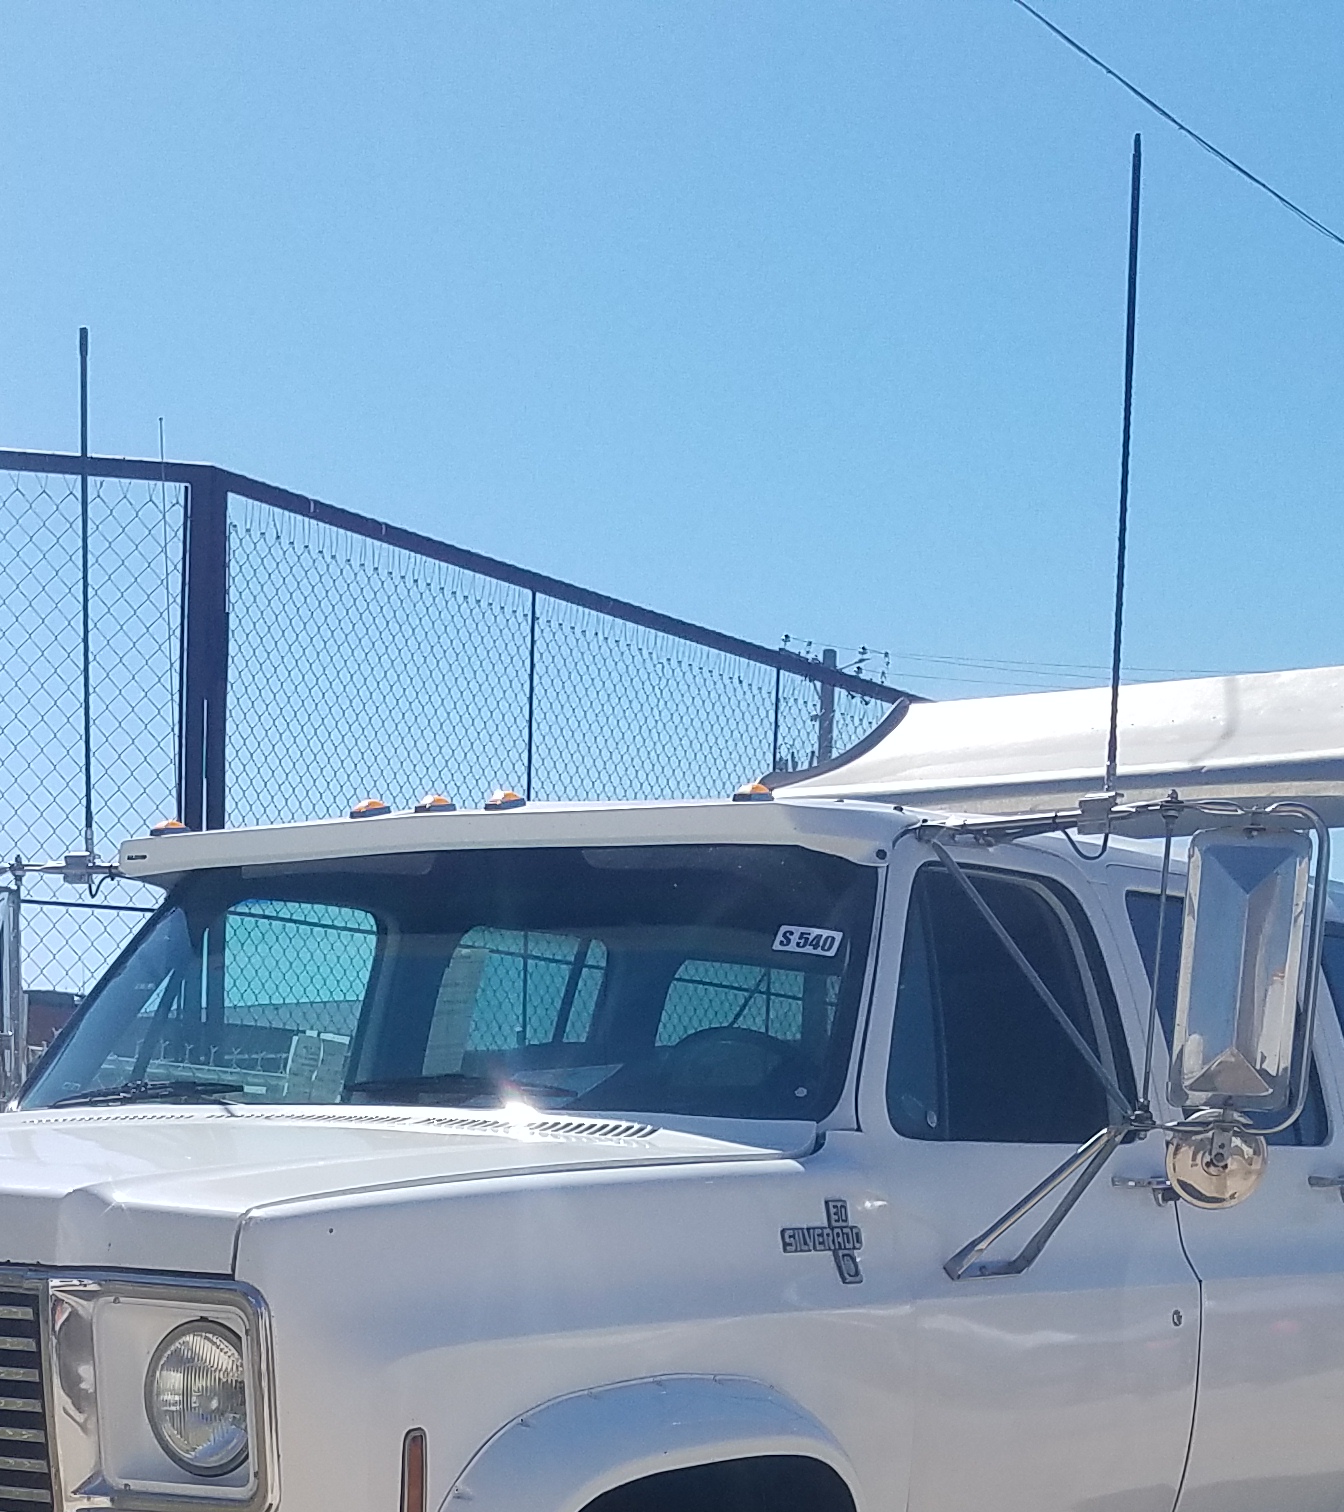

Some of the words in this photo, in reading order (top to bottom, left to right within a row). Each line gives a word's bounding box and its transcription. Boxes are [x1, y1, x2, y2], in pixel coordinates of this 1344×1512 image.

[779, 930, 794, 947] S
[796, 932, 836, 952] 540
[831, 1204, 848, 1223] 30
[782, 1226, 863, 1252] SILVERADO
